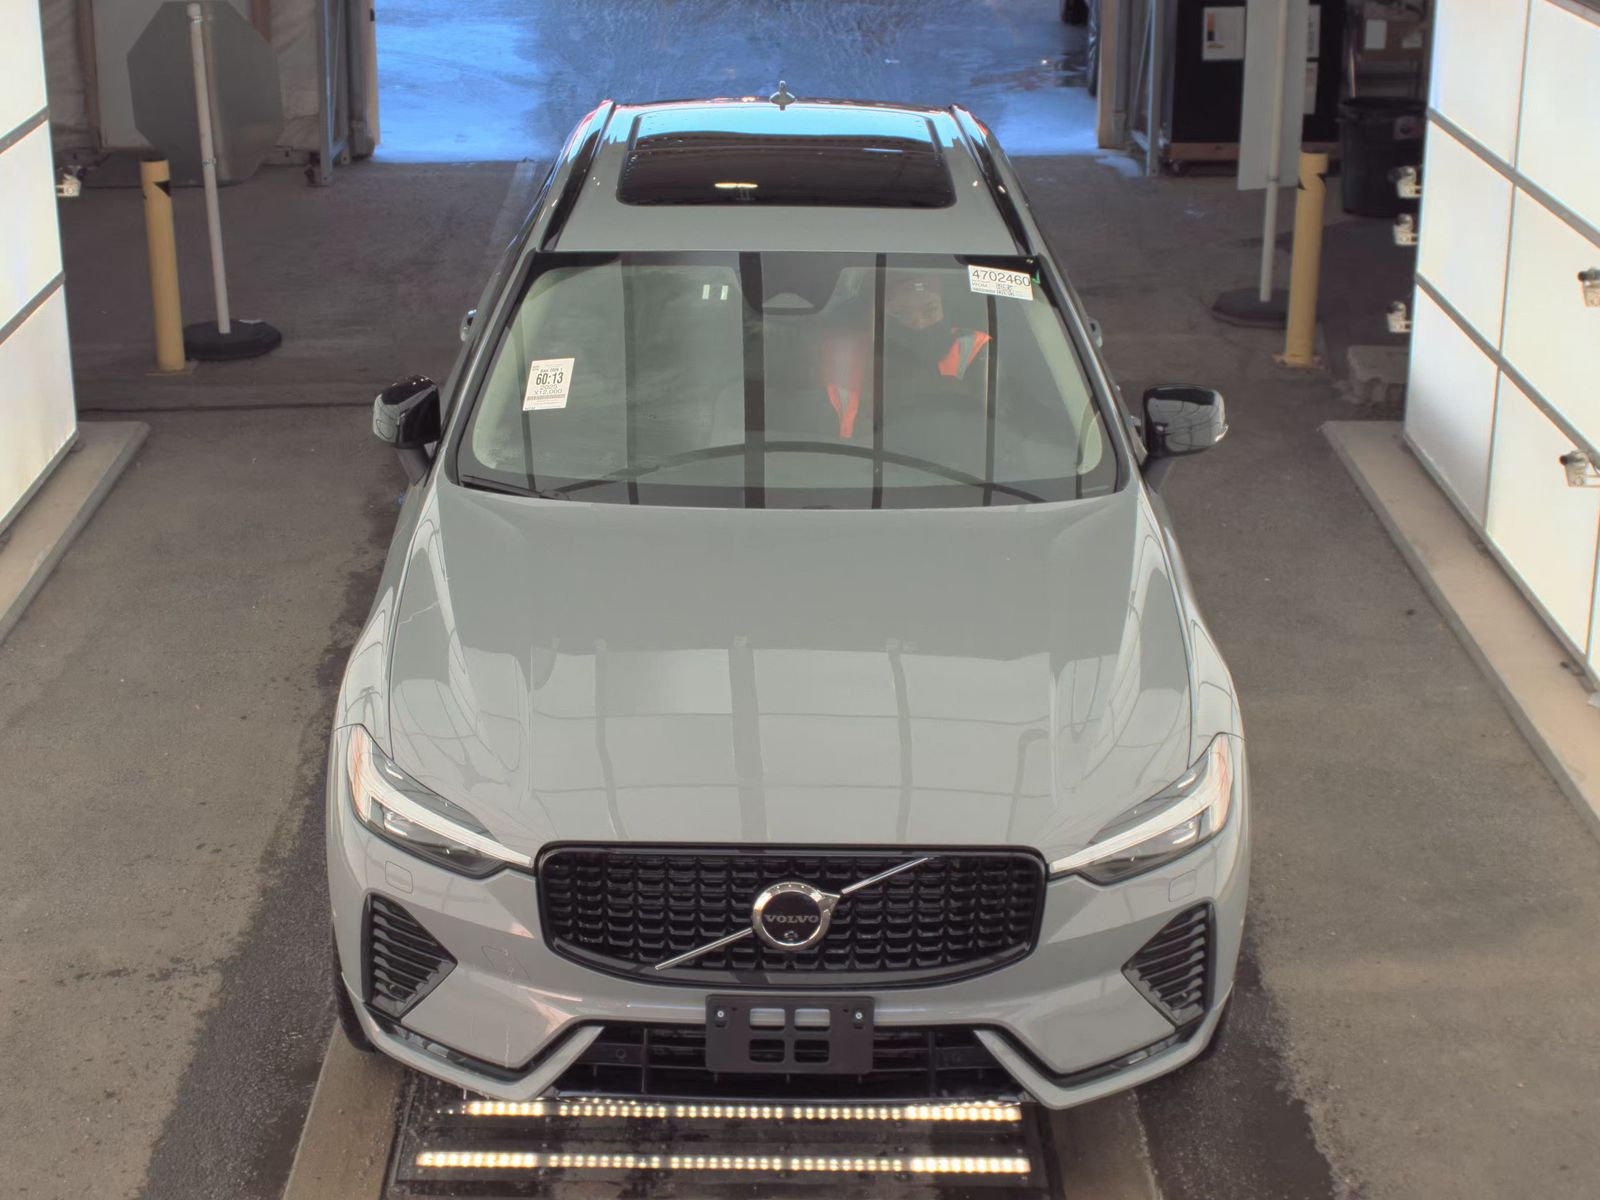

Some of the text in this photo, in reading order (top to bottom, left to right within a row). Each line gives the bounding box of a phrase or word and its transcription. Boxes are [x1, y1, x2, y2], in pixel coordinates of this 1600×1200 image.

[972, 269, 1031, 287] 4702460
[535, 372, 564, 386] 60:13
[764, 914, 819, 924] VOLVO
